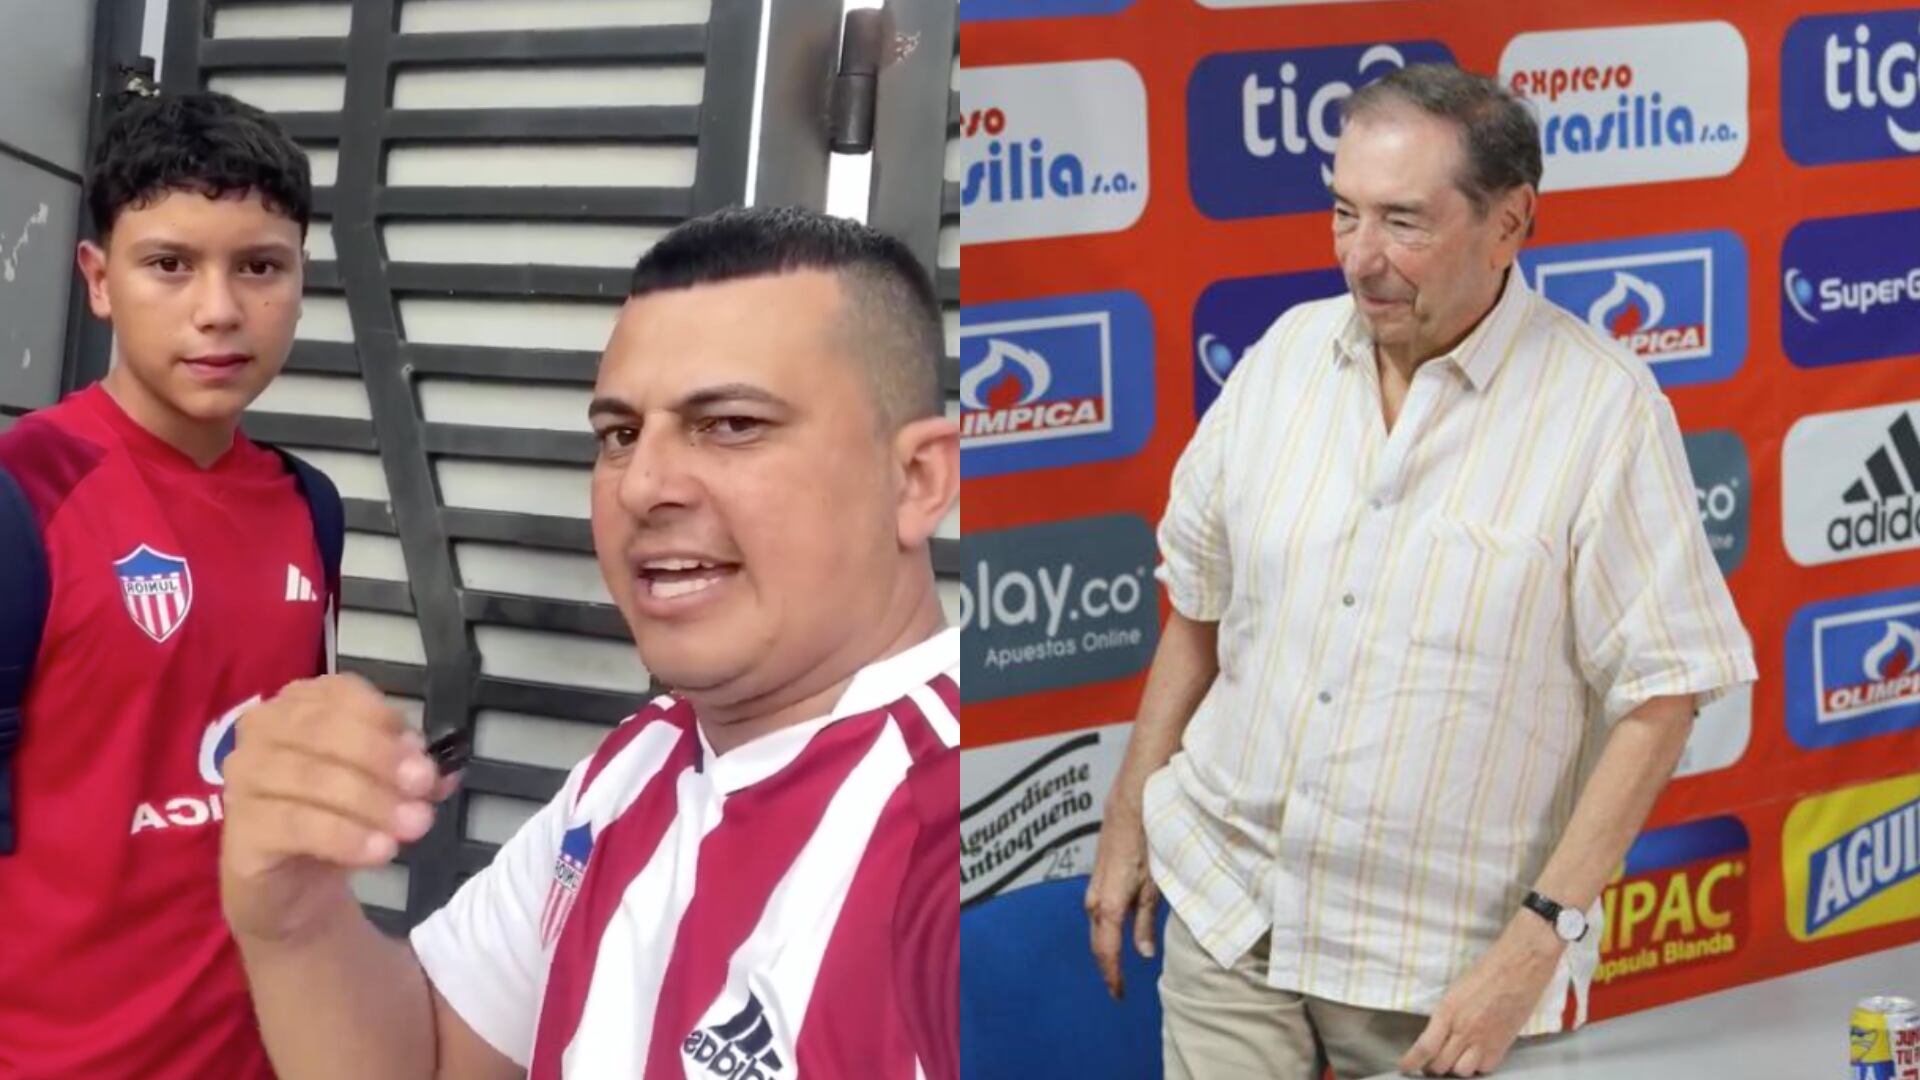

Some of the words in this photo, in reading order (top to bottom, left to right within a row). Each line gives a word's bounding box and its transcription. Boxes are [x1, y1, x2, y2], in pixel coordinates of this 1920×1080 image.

[1510, 64, 1633, 102] expreso
[1825, 23, 1920, 152] tig
[960, 107, 1006, 138] so
[1242, 62, 1380, 187] tig
[1827, 495, 1920, 552] adid
[984, 637, 1078, 671] Apuestas
[1081, 628, 1142, 653] Online
[1812, 800, 1920, 925] AGUI
[1663, 929, 1736, 965] Blanda
